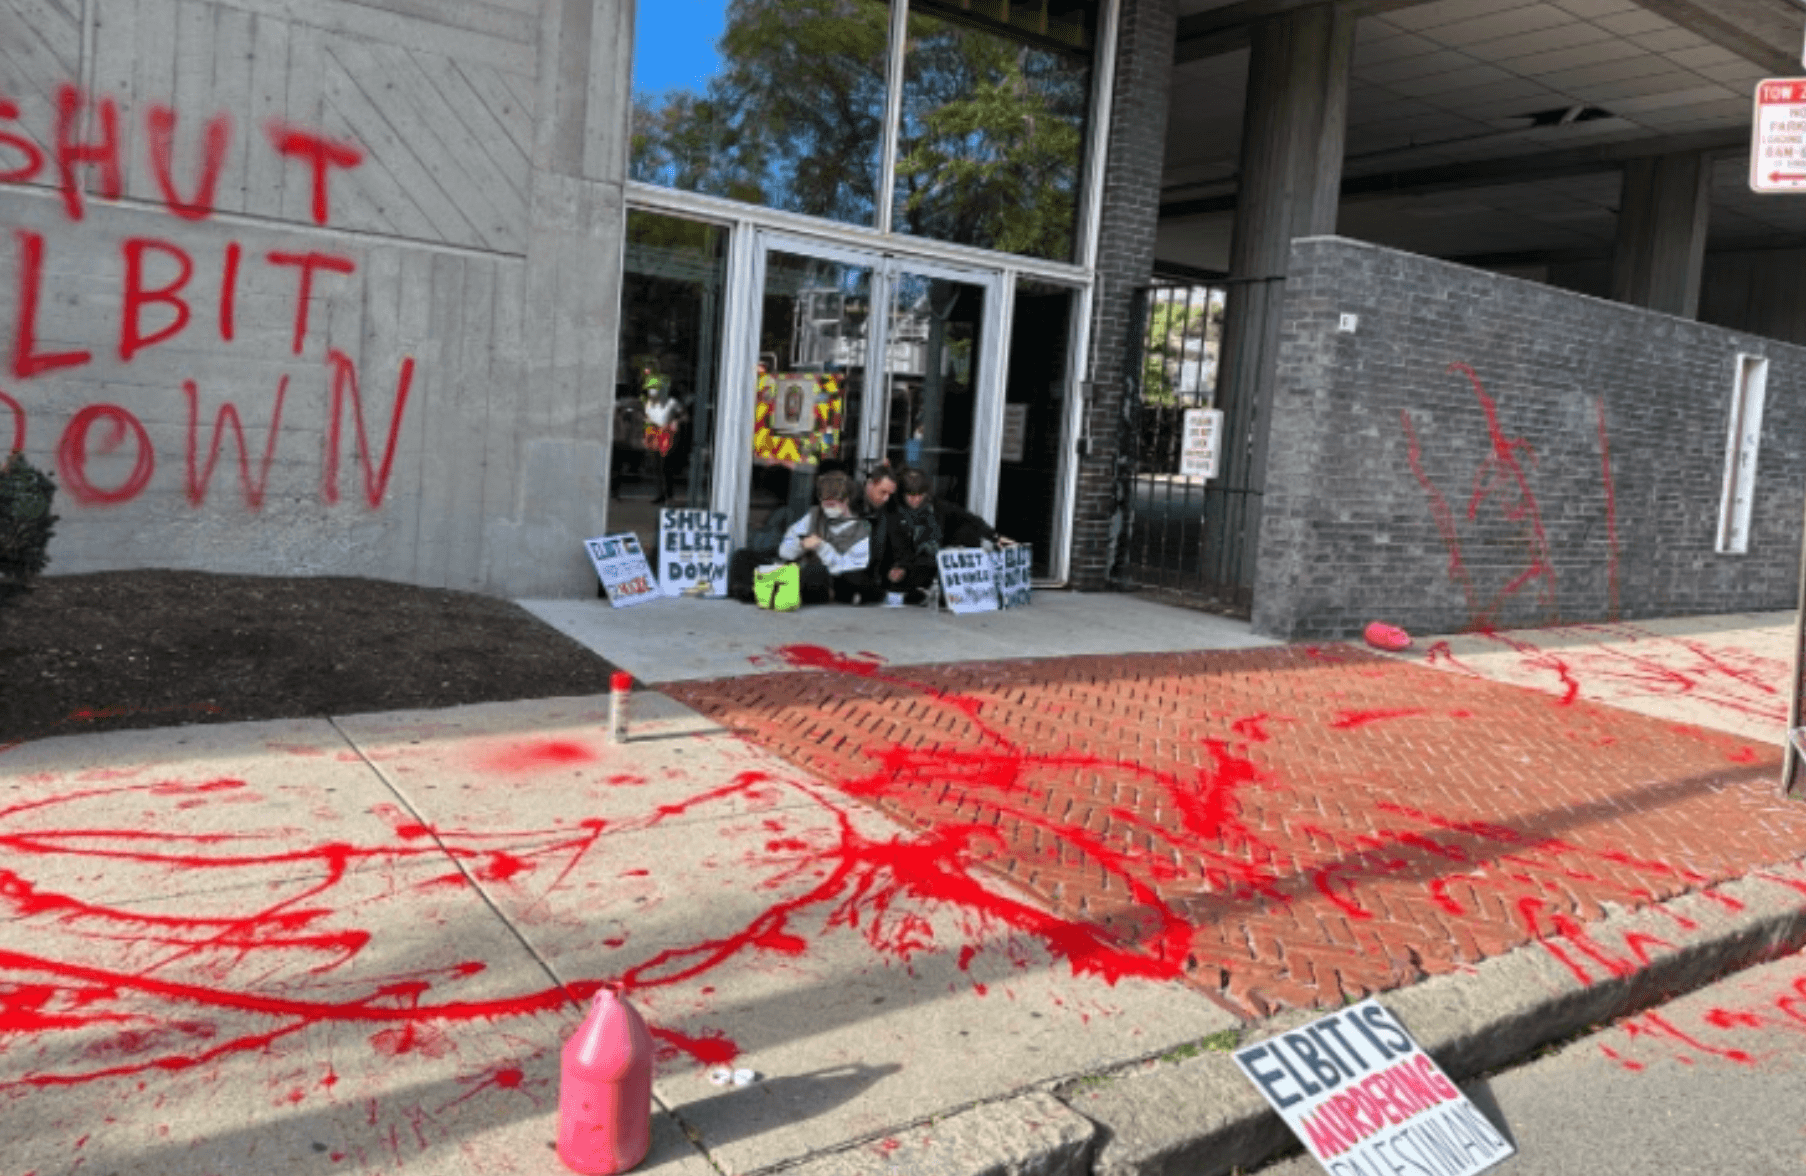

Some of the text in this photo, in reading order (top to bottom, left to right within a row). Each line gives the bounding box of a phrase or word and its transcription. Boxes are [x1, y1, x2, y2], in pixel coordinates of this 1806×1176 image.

[1763, 86, 1791, 100] TOW
[664, 511, 728, 531] SHUT
[668, 561, 726, 582] DOWN
[1237, 1005, 1413, 1110] ELBIT IS
[1299, 1052, 1460, 1161] MURDERING
